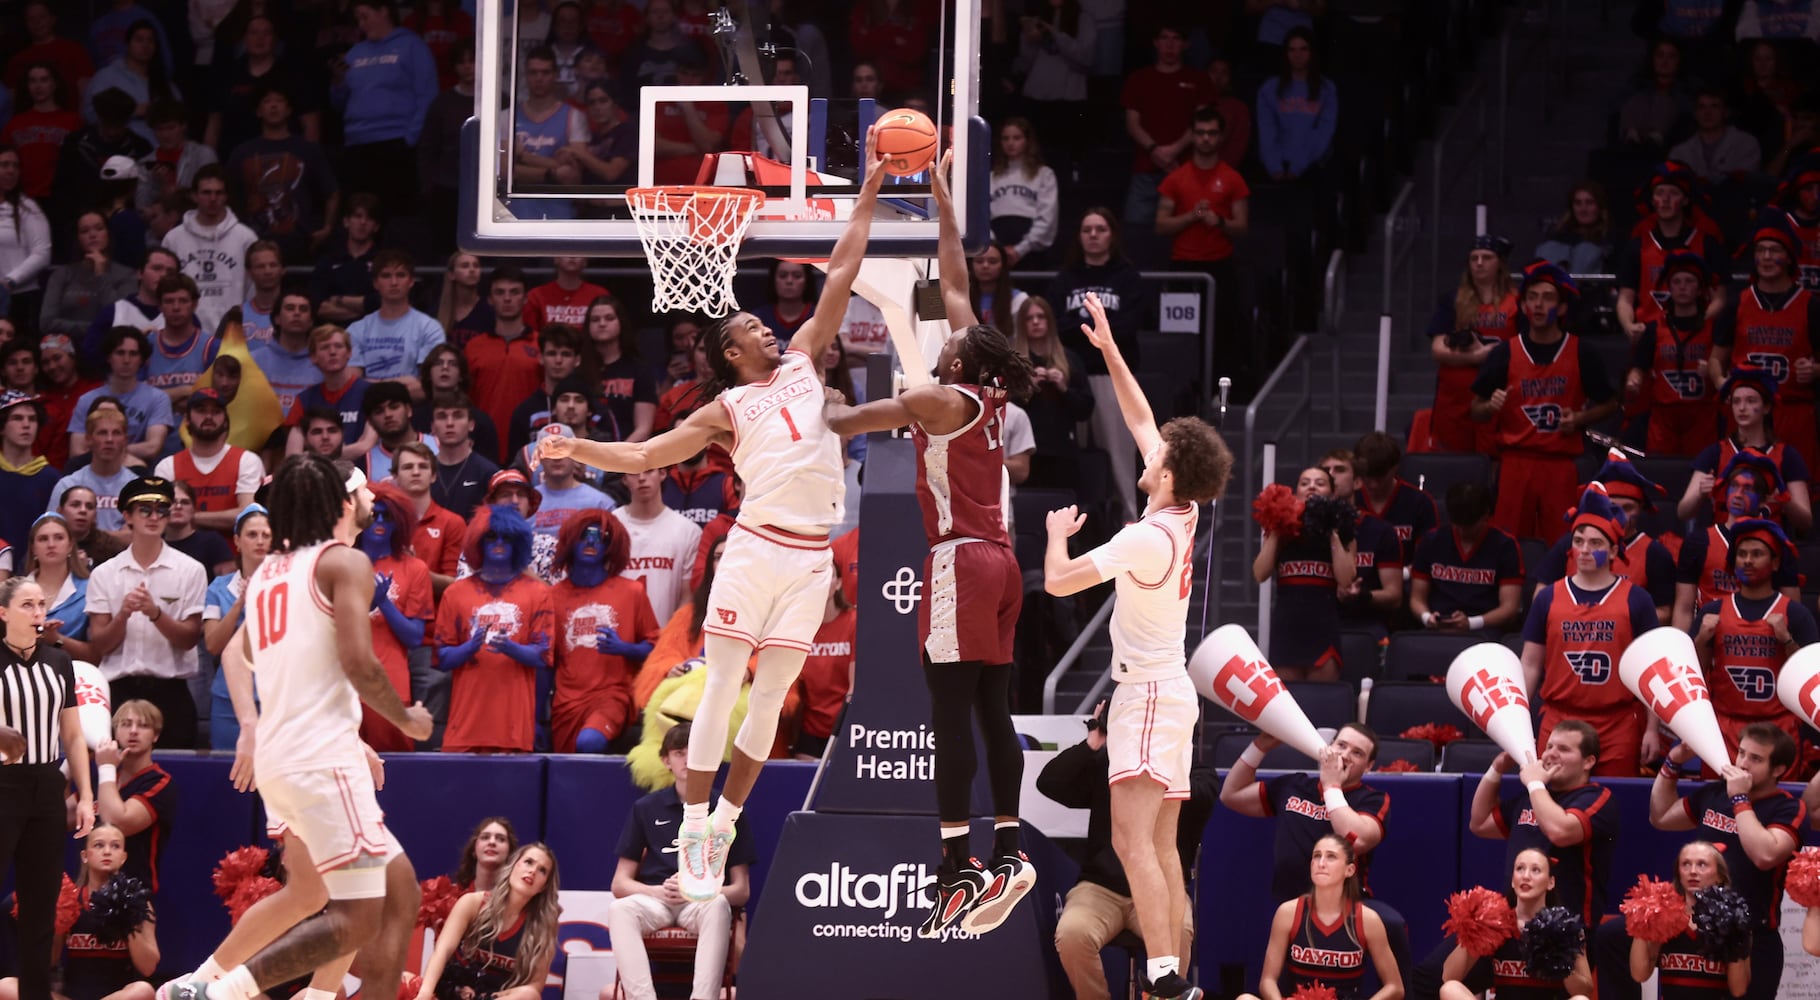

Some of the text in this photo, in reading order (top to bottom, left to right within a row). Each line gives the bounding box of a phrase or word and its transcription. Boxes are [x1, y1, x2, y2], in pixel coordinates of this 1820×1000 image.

[990, 184, 1038, 206] AYTON
[1166, 306, 1195, 321] 108
[744, 376, 814, 423] DAYTON
[781, 407, 801, 442] 1
[624, 557, 675, 570] AYTON
[1431, 562, 1496, 585] DAYTON
[257, 582, 290, 652] 10
[1563, 620, 1616, 631] DAYTON
[1564, 631, 1614, 643] FLYERS
[1723, 634, 1778, 648] DAYTON
[1725, 646, 1777, 658] FLYERS
[850, 724, 935, 750] Premie
[813, 922, 912, 942] connecting
[1291, 944, 1363, 968] DAYTON
[1493, 959, 1529, 978] DAY
